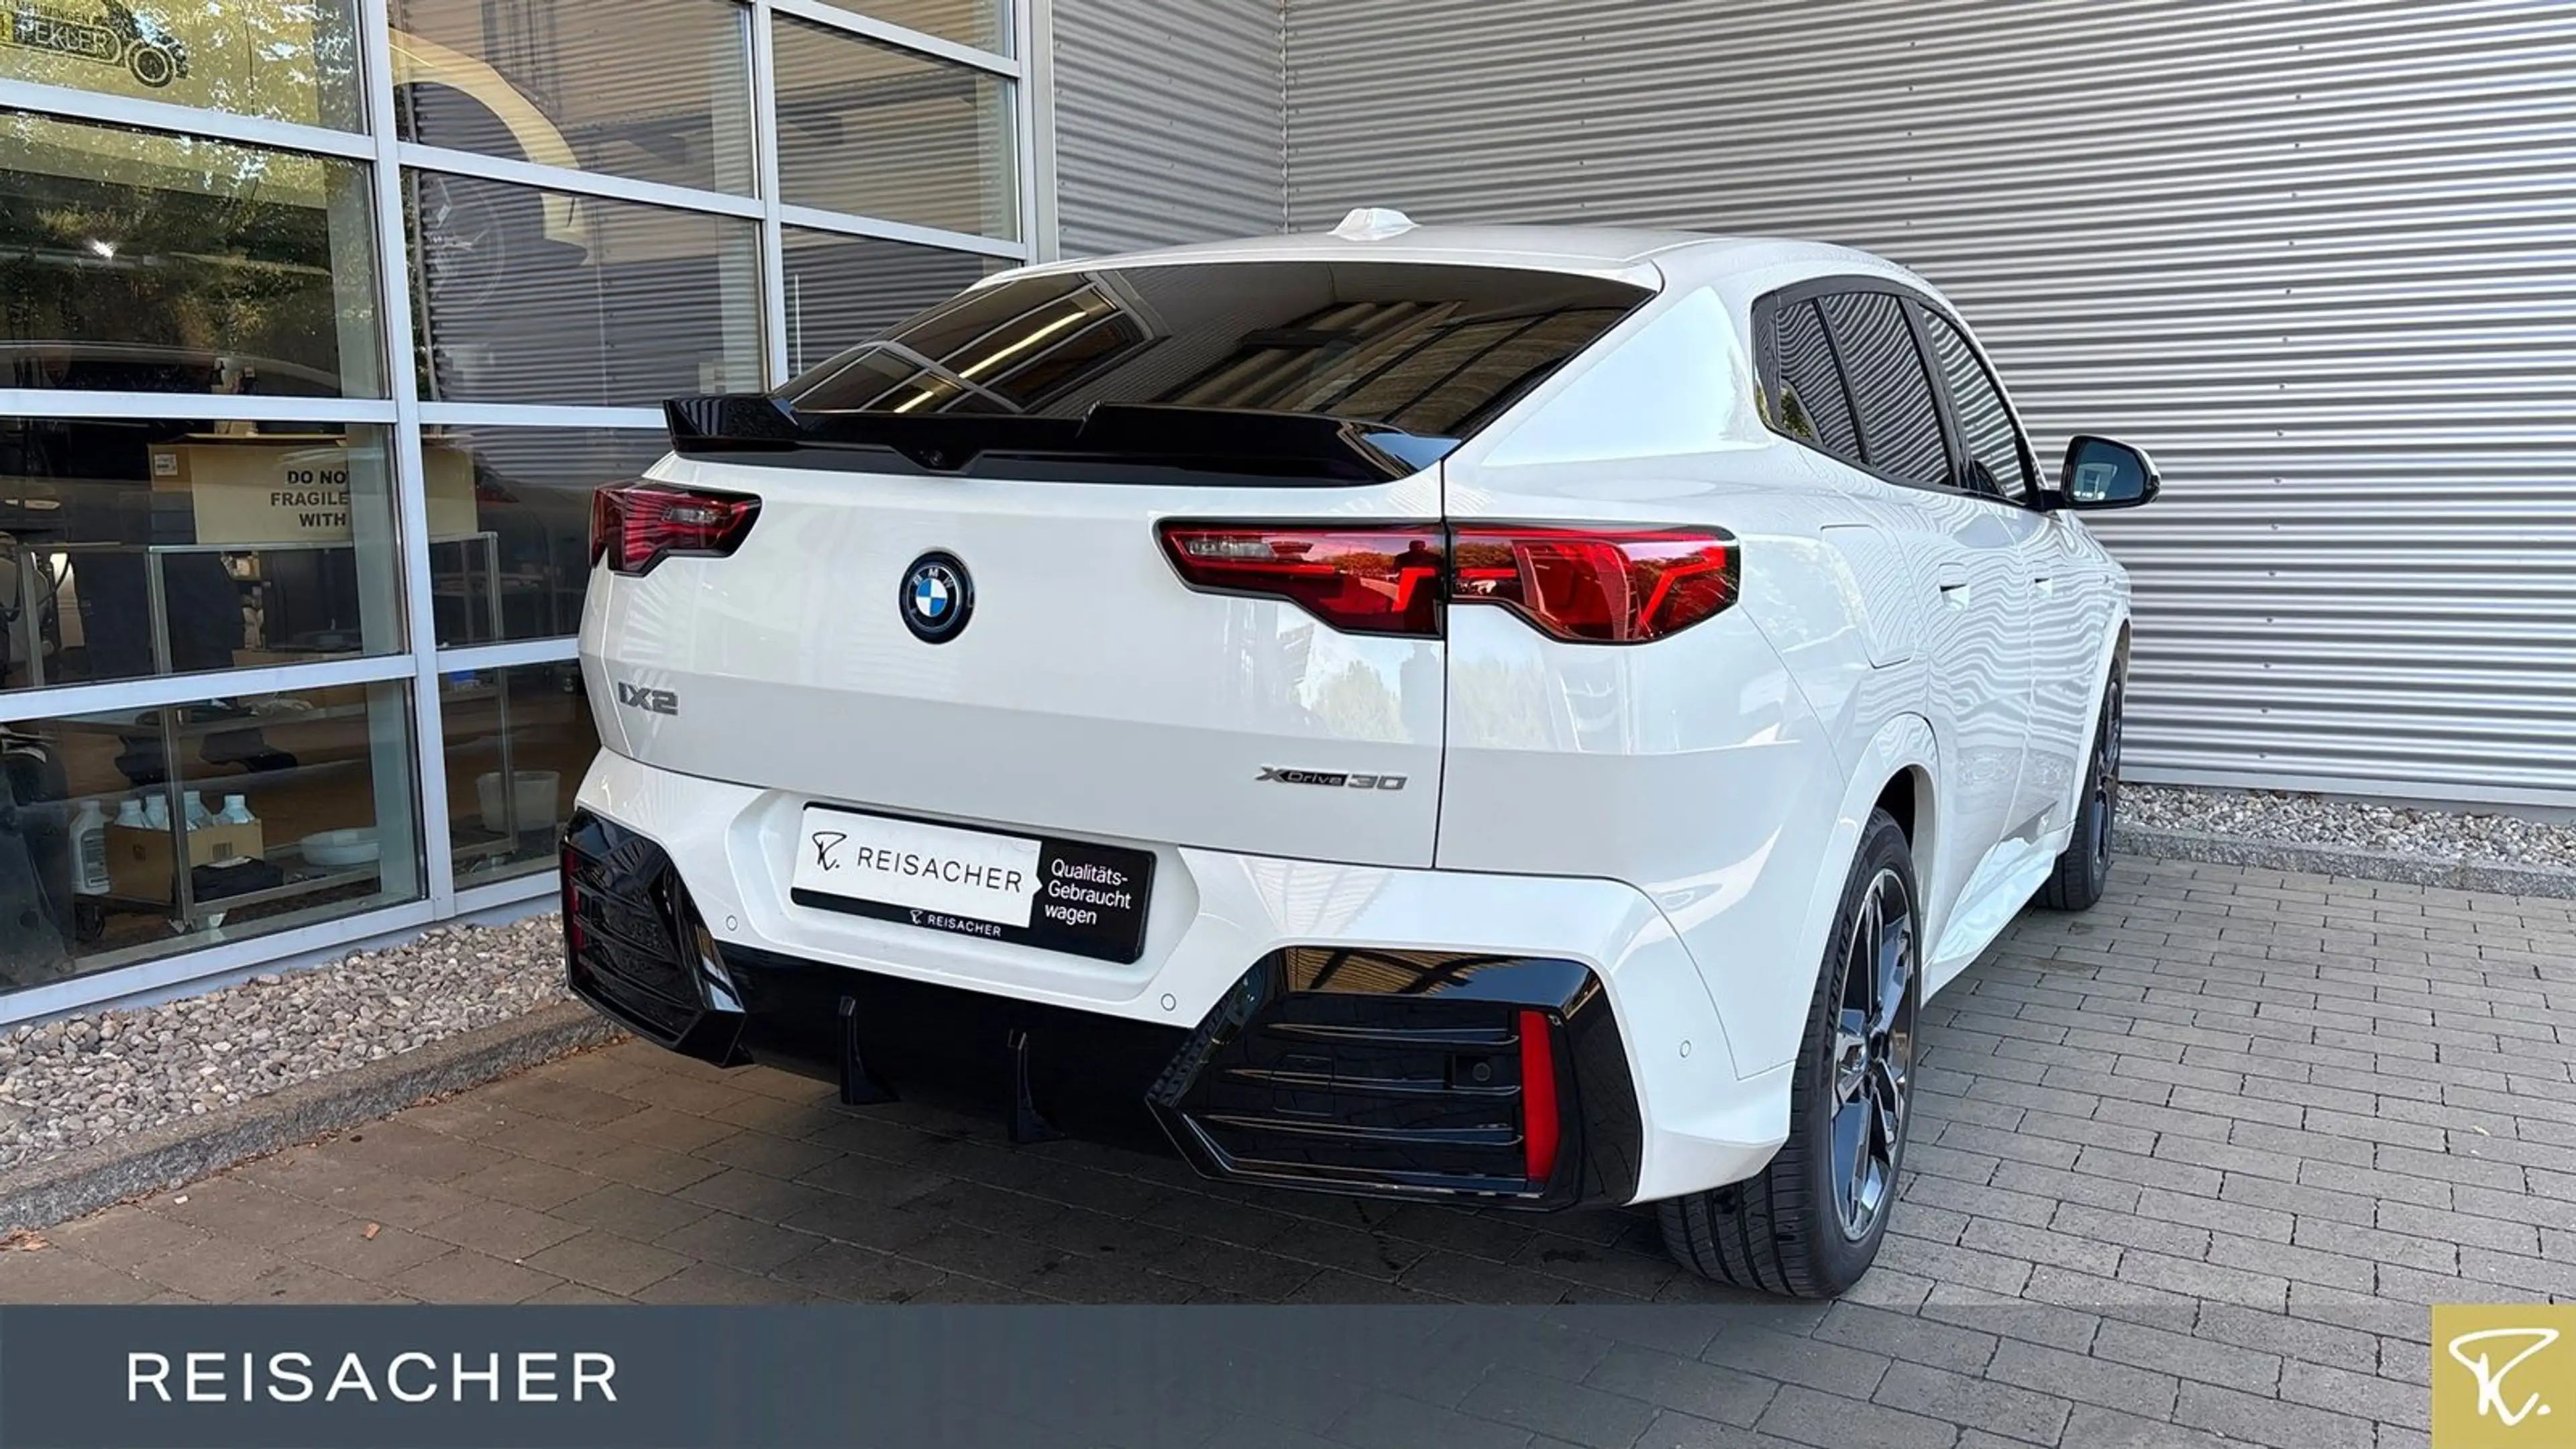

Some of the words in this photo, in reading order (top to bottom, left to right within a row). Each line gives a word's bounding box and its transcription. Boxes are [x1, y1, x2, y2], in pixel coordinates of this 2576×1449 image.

[287, 470, 313, 484] DO
[320, 470, 349, 484] NO
[270, 492, 351, 506] FRAGILE
[299, 513, 346, 527] WITH
[912, 568, 955, 589] BMW
[857, 846, 1022, 893] REISACHER
[1051, 858, 1128, 886] Qualitäts-
[1048, 879, 1132, 910] Gebraucht
[928, 914, 1002, 937] REISACHER
[1044, 904, 1097, 926] wagen
